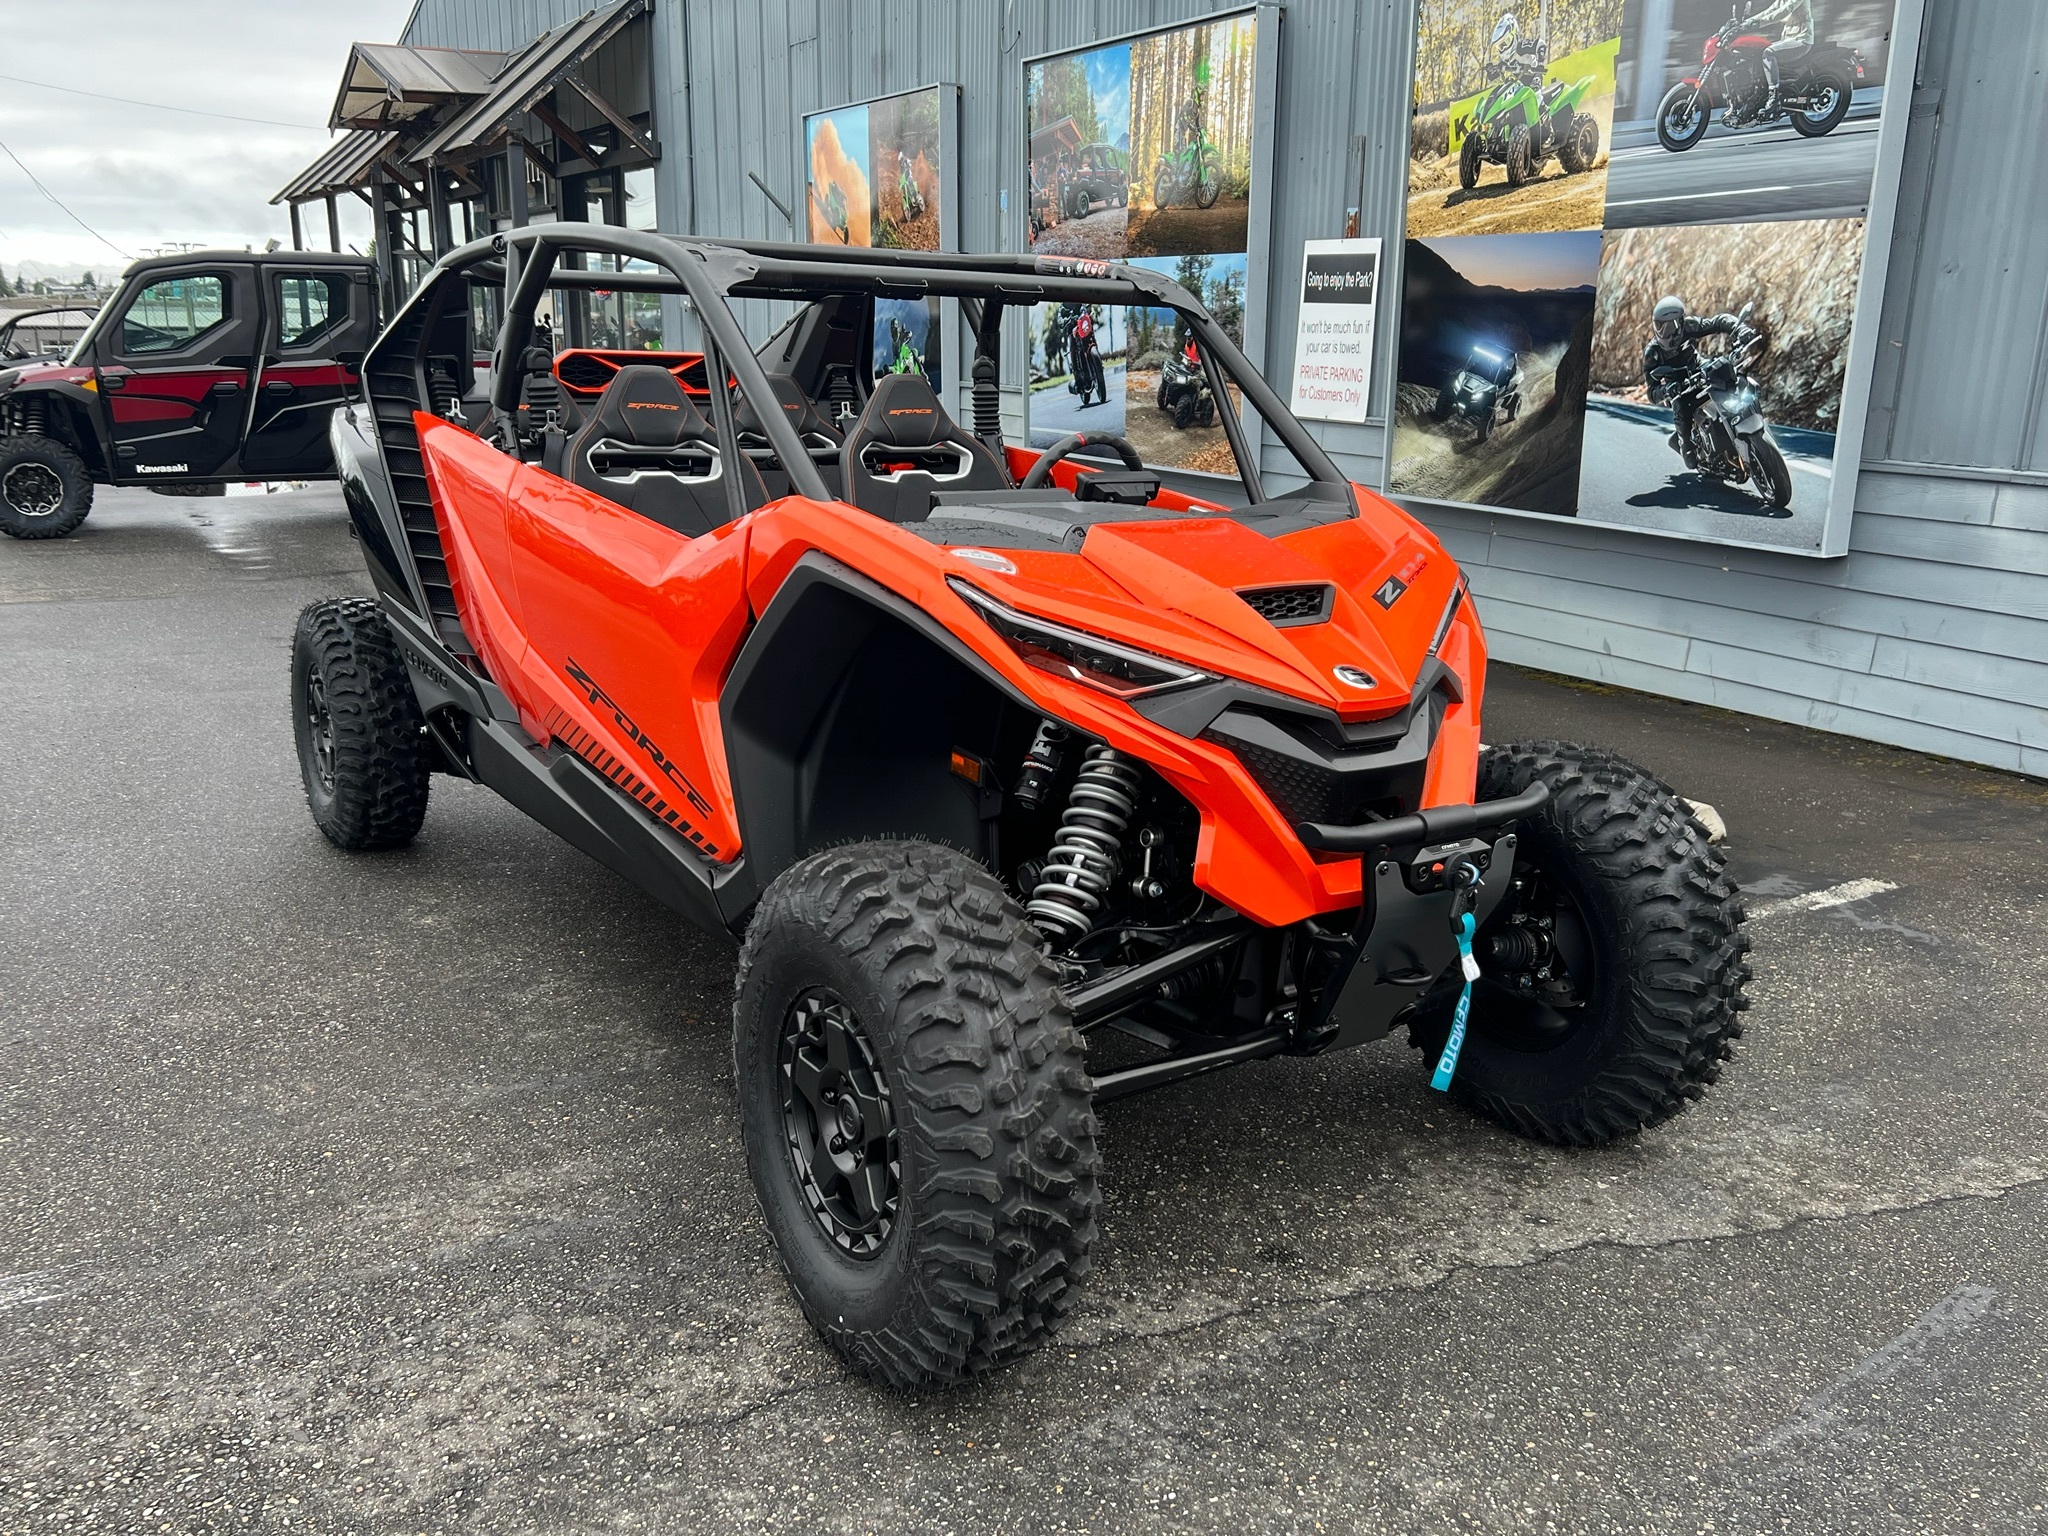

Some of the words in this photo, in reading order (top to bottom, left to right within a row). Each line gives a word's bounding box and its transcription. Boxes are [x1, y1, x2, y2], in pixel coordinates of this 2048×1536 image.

[1307, 271, 1323, 290] Going
[1323, 272, 1330, 287] to
[1330, 271, 1345, 291] enjoy
[1345, 271, 1354, 287] the
[1354, 271, 1373, 287] Park?
[1301, 320, 1306, 333] It
[1306, 320, 1323, 334] won't
[1323, 320, 1332, 334] be
[1332, 320, 1352, 334] much
[1352, 320, 1363, 334] fun
[1364, 320, 1371, 334] if
[1305, 343, 1320, 356] your
[1320, 343, 1331, 353] car
[1331, 340, 1339, 353] is
[1339, 341, 1361, 354] towed.
[1300, 364, 1328, 380] PRIVATE
[1329, 366, 1363, 383] PARKING
[1299, 384, 1308, 399] for
[1308, 385, 1343, 402] Customers
[1344, 388, 1361, 407] Only
[135, 463, 189, 474] Kawasaki
[565, 655, 714, 821] ZFORCE
[1439, 993, 1471, 1075] CFMOTO
